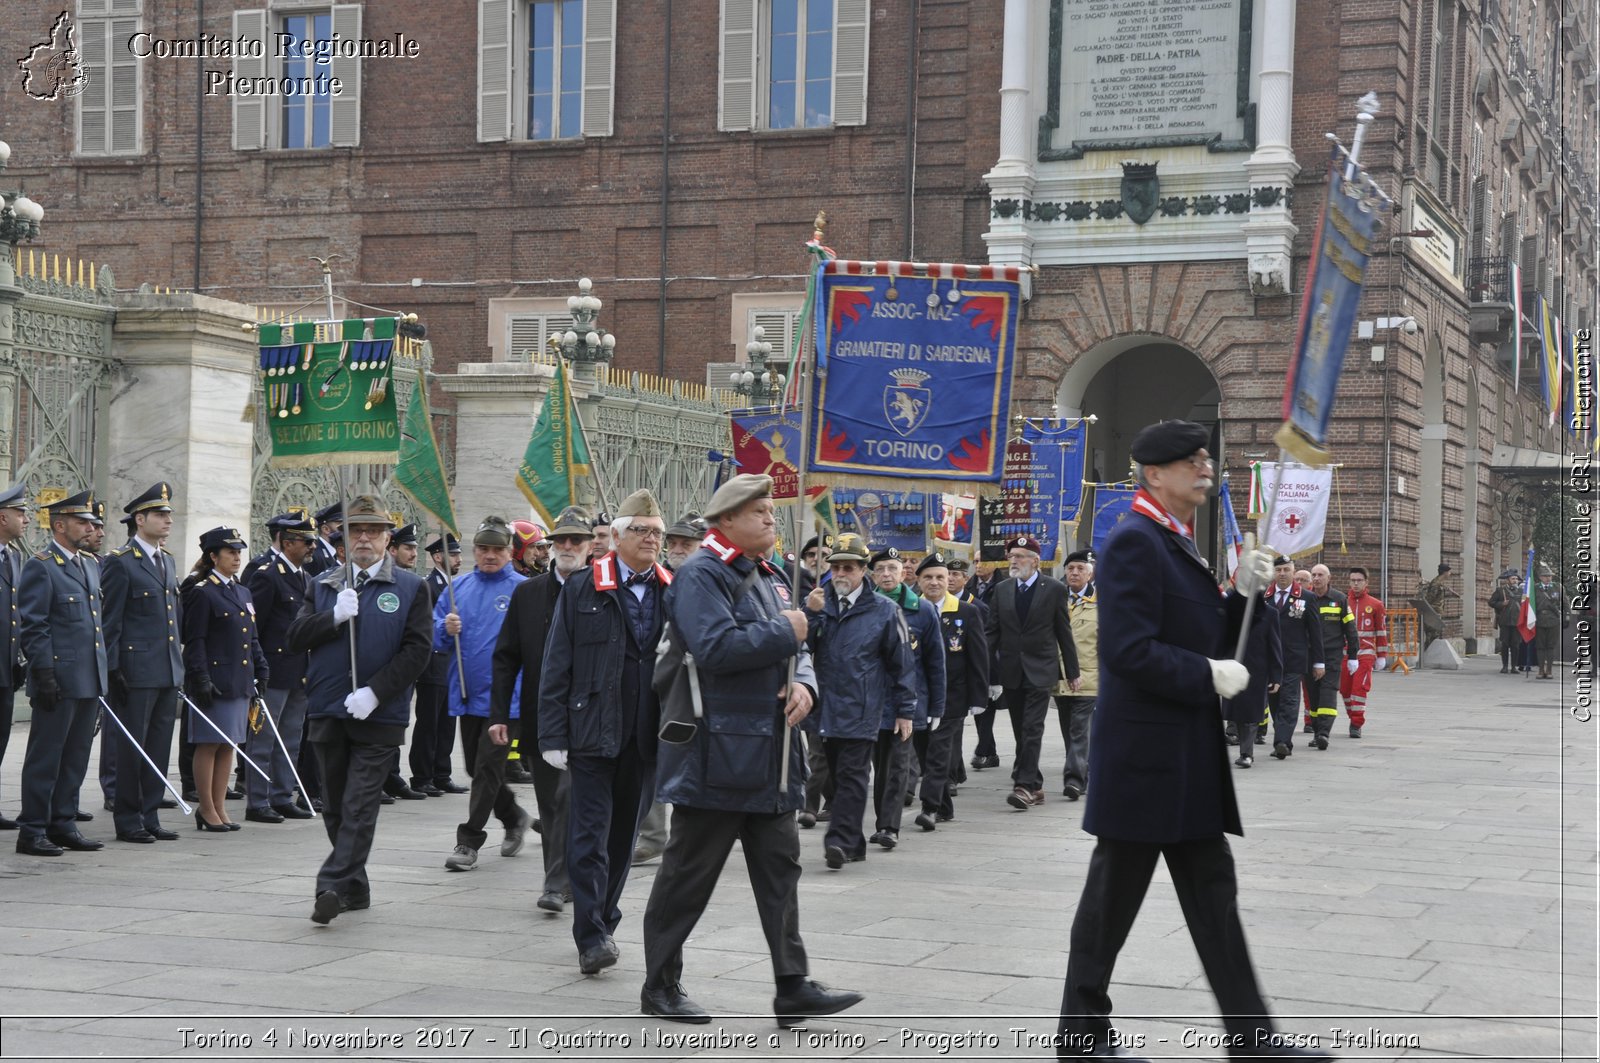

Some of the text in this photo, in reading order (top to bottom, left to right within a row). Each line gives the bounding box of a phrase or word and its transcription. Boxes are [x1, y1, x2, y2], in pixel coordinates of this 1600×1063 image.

[1110, 9, 1141, 17] ARDIMENTI
[1200, 2, 1232, 10] ALLEANZE
[1073, 43, 1112, 52] ACCLAMATO
[1197, 35, 1228, 44] CAPITALE
[1110, 33, 1137, 41] NAZIONE
[1096, 49, 1201, 64] PADRE DELLA PATRIA
[1148, 65, 1177, 73] RICORDO
[1168, 87, 1206, 96] COMPIANTO
[835, 340, 992, 364] GRANATIERI DI SARDEGNA
[276, 421, 395, 444] SEZIONE di TORINO
[550, 379, 564, 473] SEZIONE DI TORINO
[864, 439, 944, 461] TORINO
[1269, 482, 1320, 491] COCE ROSSA
